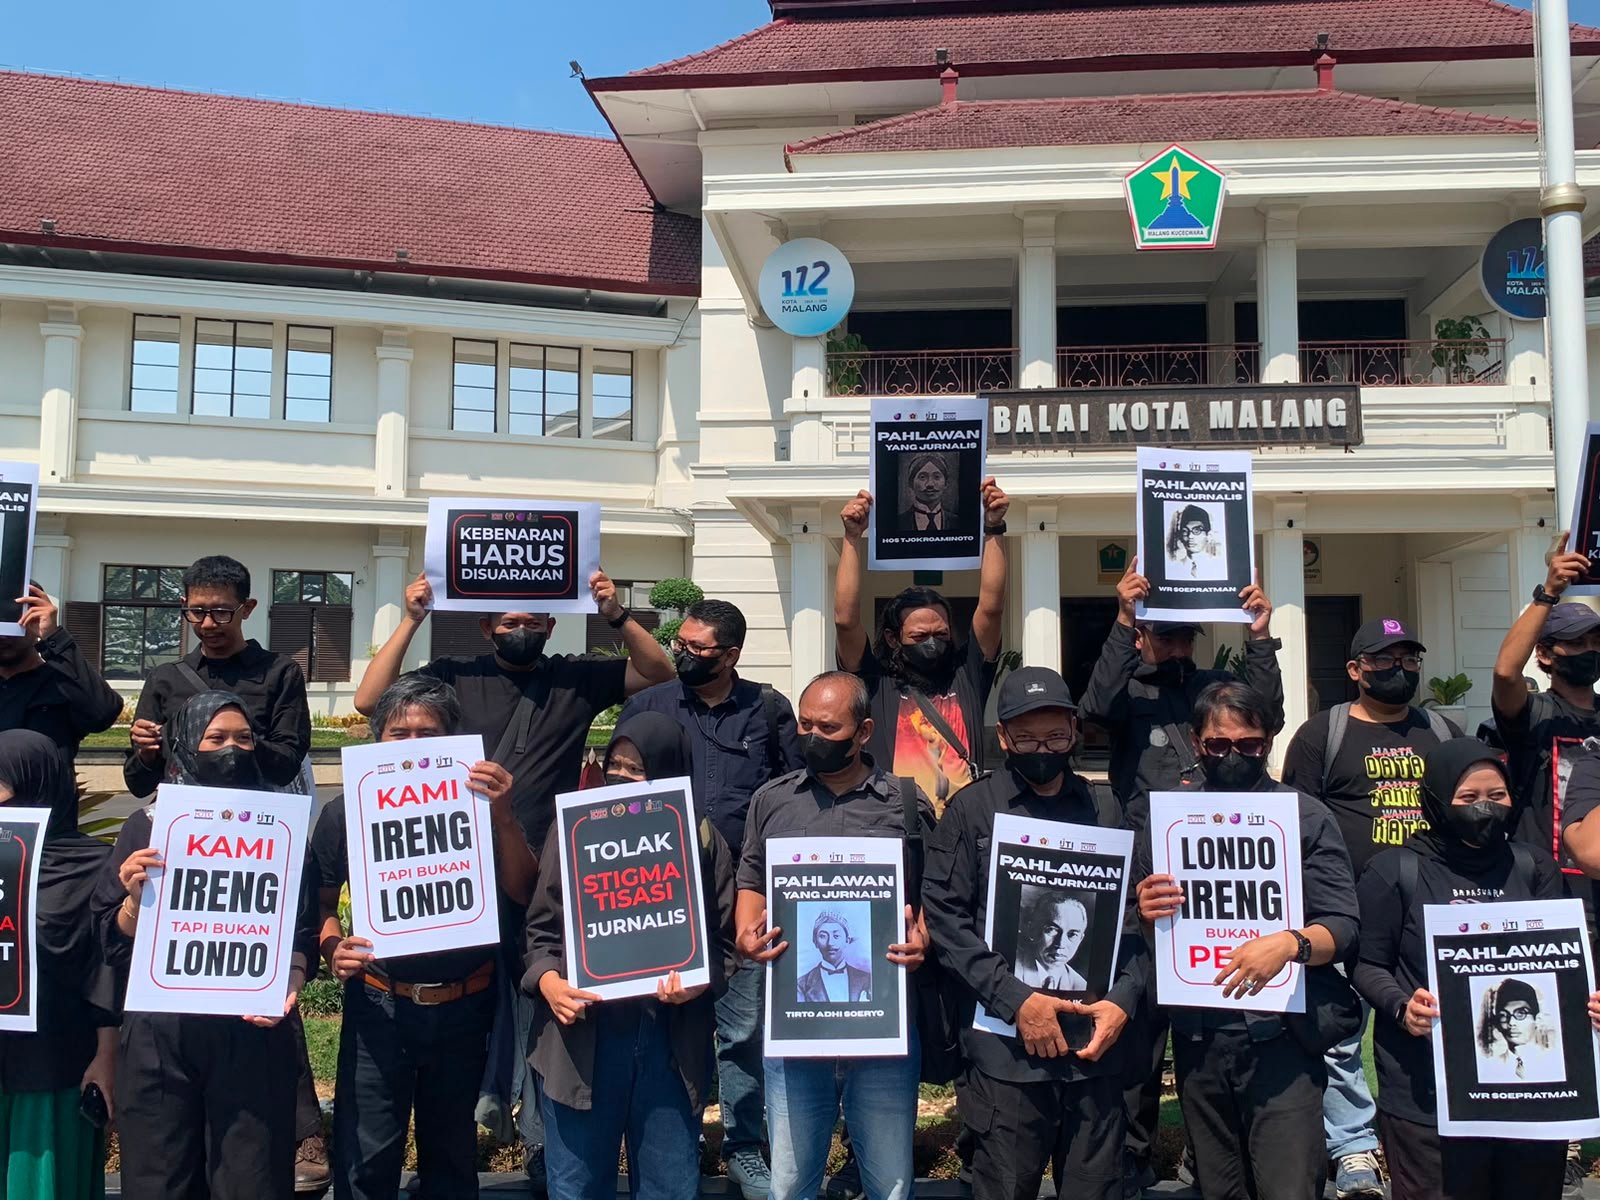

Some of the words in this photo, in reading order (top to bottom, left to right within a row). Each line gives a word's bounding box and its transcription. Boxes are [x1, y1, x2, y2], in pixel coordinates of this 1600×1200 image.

[782, 261, 830, 296] 112
[1506, 287, 1546, 295] MALAN
[782, 304, 827, 313] MALANG
[993, 403, 1089, 434] BALAI
[1108, 402, 1189, 432] KOTA
[1209, 398, 1347, 430] MALANG
[877, 429, 980, 441] PAHLAWAN
[885, 443, 918, 451] YANG
[919, 442, 977, 451] JURNALIS
[1144, 479, 1245, 491] PAHLAWAN
[1152, 491, 1182, 500] YANG
[1184, 493, 1242, 501] JURNALIS
[460, 527, 564, 541] KEBENARAN
[461, 543, 565, 567] HARUS
[461, 568, 563, 581] DISUARAKAN
[1365, 755, 1425, 778] DATA
[377, 779, 459, 810] KAMI
[186, 834, 275, 860] KAMI
[371, 810, 472, 863] IRENG
[584, 831, 673, 863] TOLAK
[1181, 836, 1275, 870] LONDO
[378, 868, 412, 883] TAPI
[417, 860, 470, 877] BUKAN
[583, 861, 681, 894] STIGMA
[999, 854, 1122, 879] PAHLAWAN
[169, 867, 279, 914] IRENG
[774, 875, 894, 888] PAHLAWAN
[1007, 871, 1047, 884] YANG
[1048, 878, 1117, 891] JURNALIS
[380, 877, 475, 923] LONDO
[593, 882, 673, 912] TISASI
[782, 891, 820, 899] YANG
[822, 890, 892, 899] JURNALIS
[1180, 879, 1283, 921] IRENG
[171, 921, 208, 934] TAPI
[212, 922, 270, 935] BUKAN
[587, 908, 687, 939] JURNALIS
[1206, 928, 1260, 939] BUKAN
[165, 939, 268, 978] LONDO
[1189, 945, 1234, 969] PE
[1437, 941, 1581, 960] PAHLAWAN
[1450, 964, 1496, 973] YANG
[1498, 960, 1580, 972] JURNALIS
[1491, 1090, 1578, 1099] SOEPRATMAN
